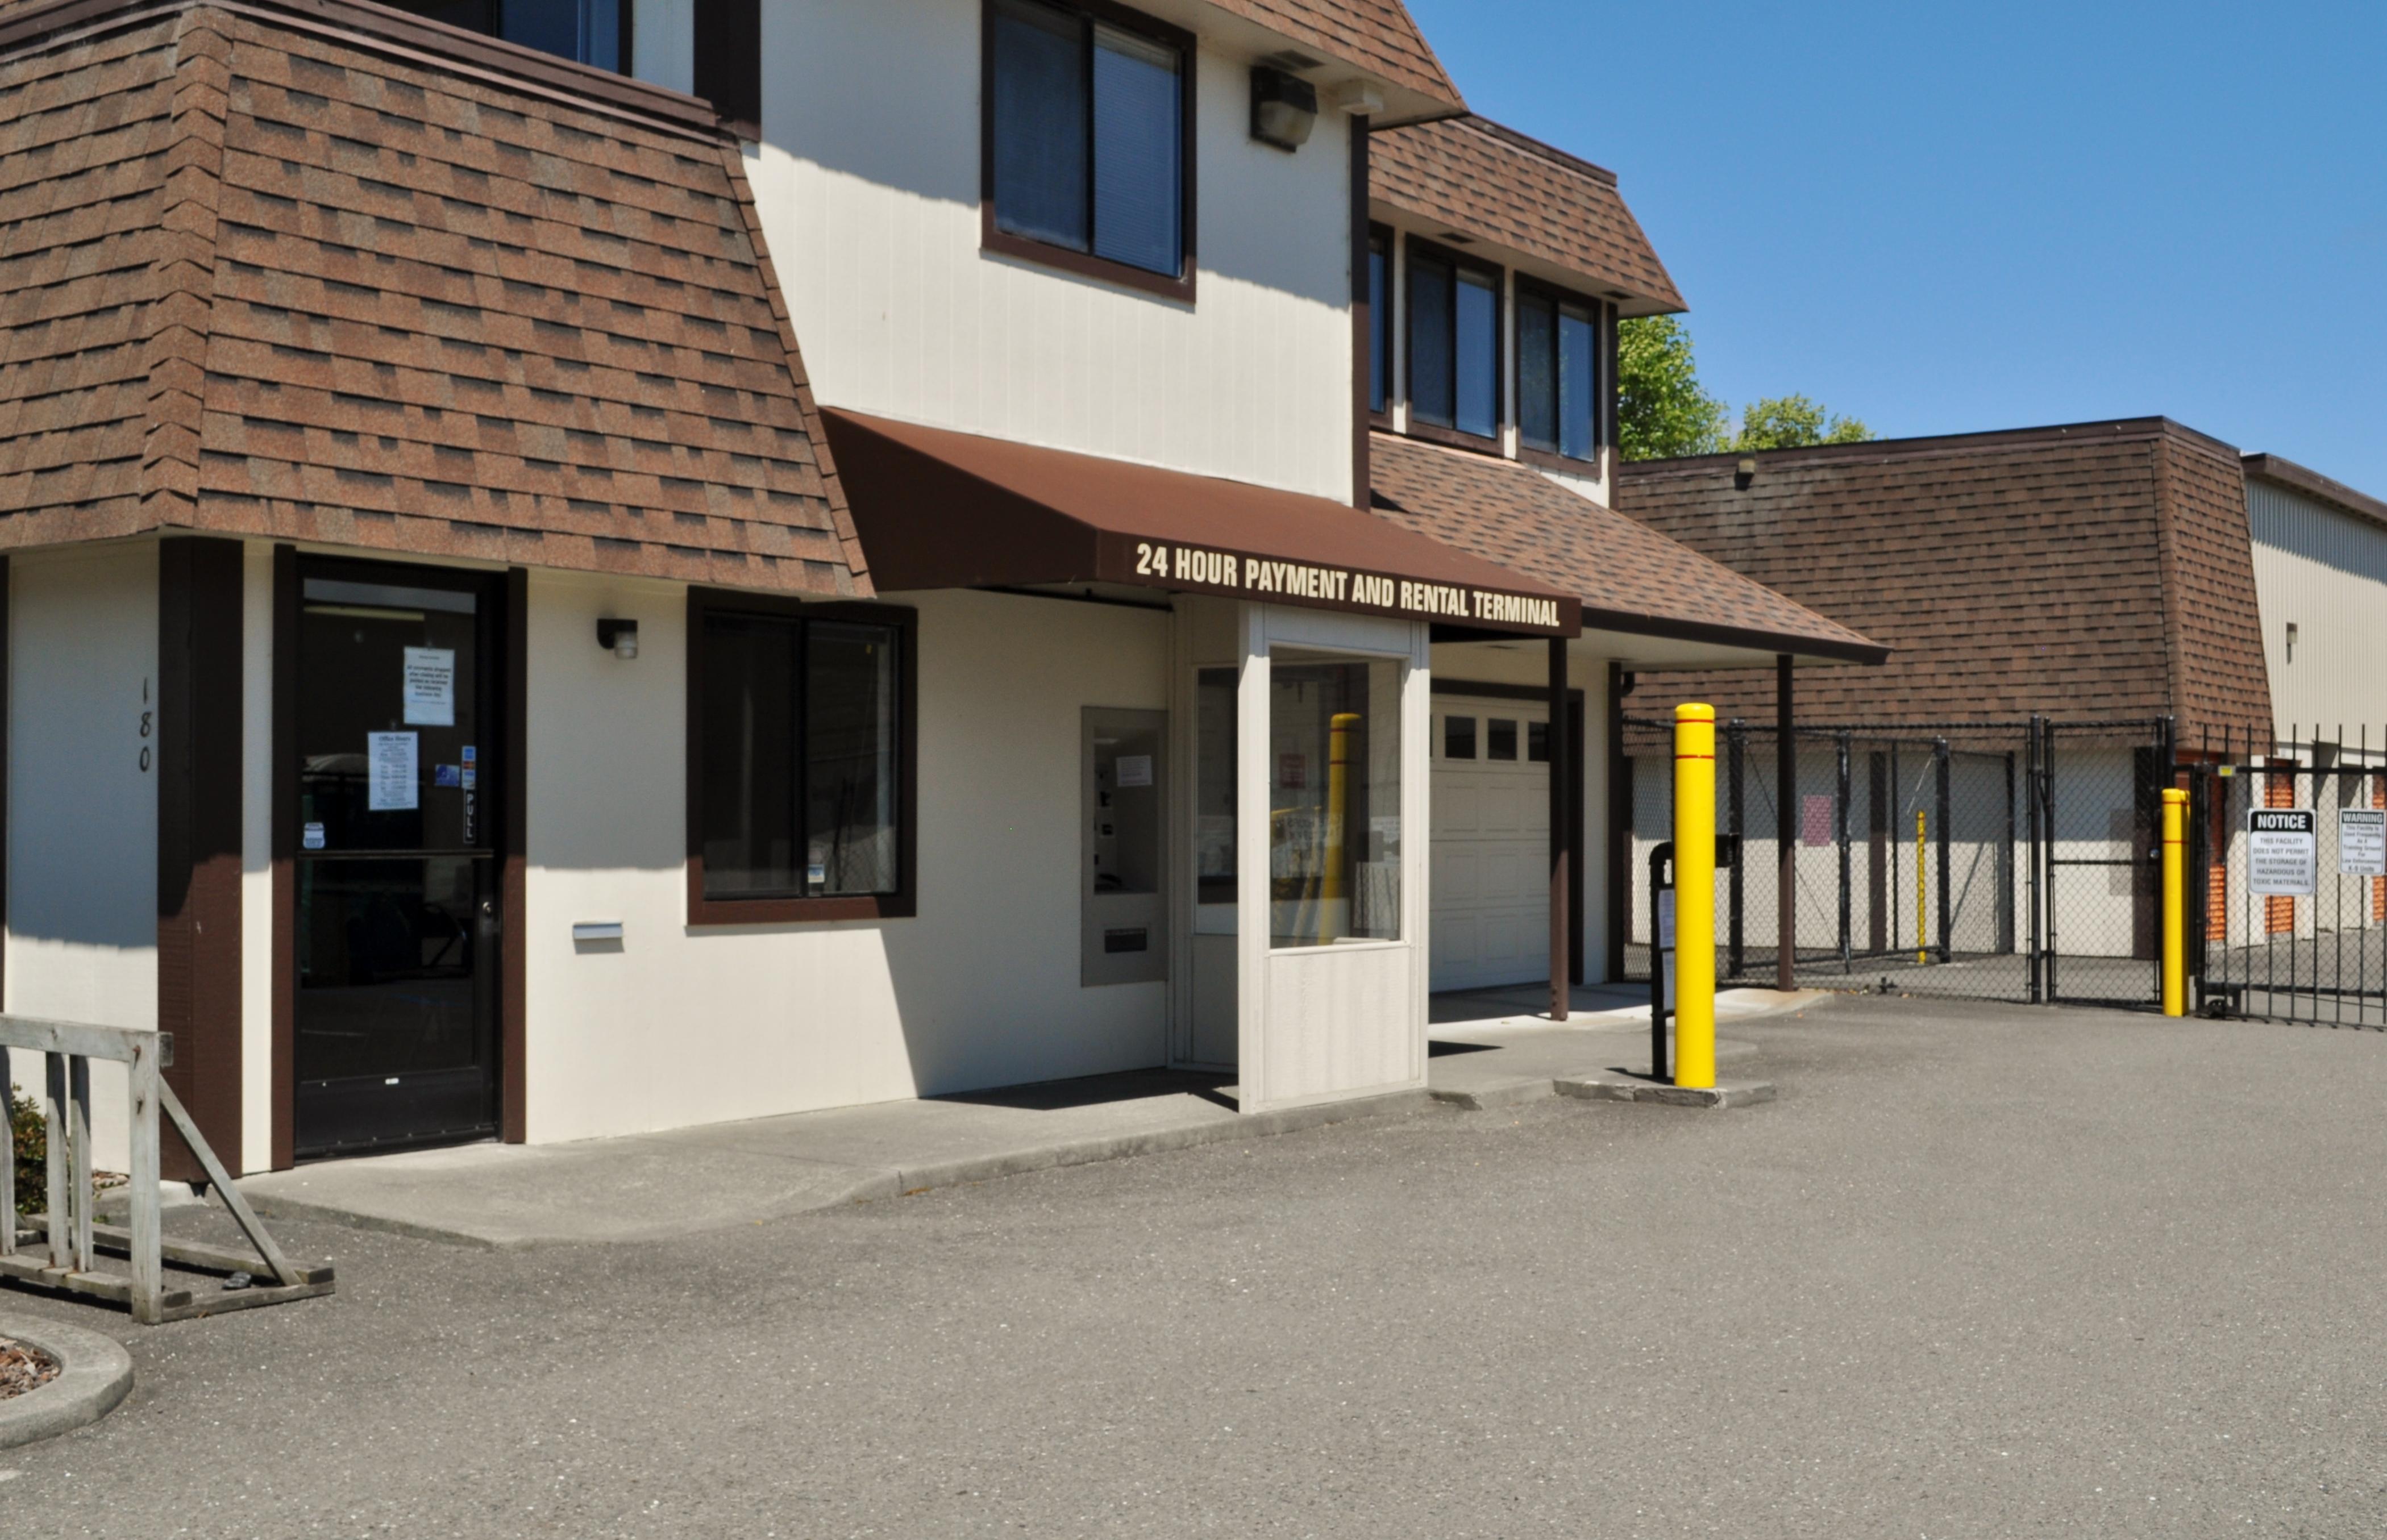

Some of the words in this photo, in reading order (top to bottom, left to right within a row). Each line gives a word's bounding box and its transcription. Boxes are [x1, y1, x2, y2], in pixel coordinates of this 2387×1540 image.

[1137, 543, 1168, 577] 24
[1175, 548, 1237, 587] HOUR
[1245, 559, 1348, 601] PAYMENT
[1351, 574, 1394, 607] AND
[1400, 581, 1469, 617] RENTAL
[1473, 590, 1560, 627] TERMINAL
[140, 677, 152, 773] 180
[2257, 814, 2306, 829] NOTICE
[2343, 813, 2382, 823] WARNING
